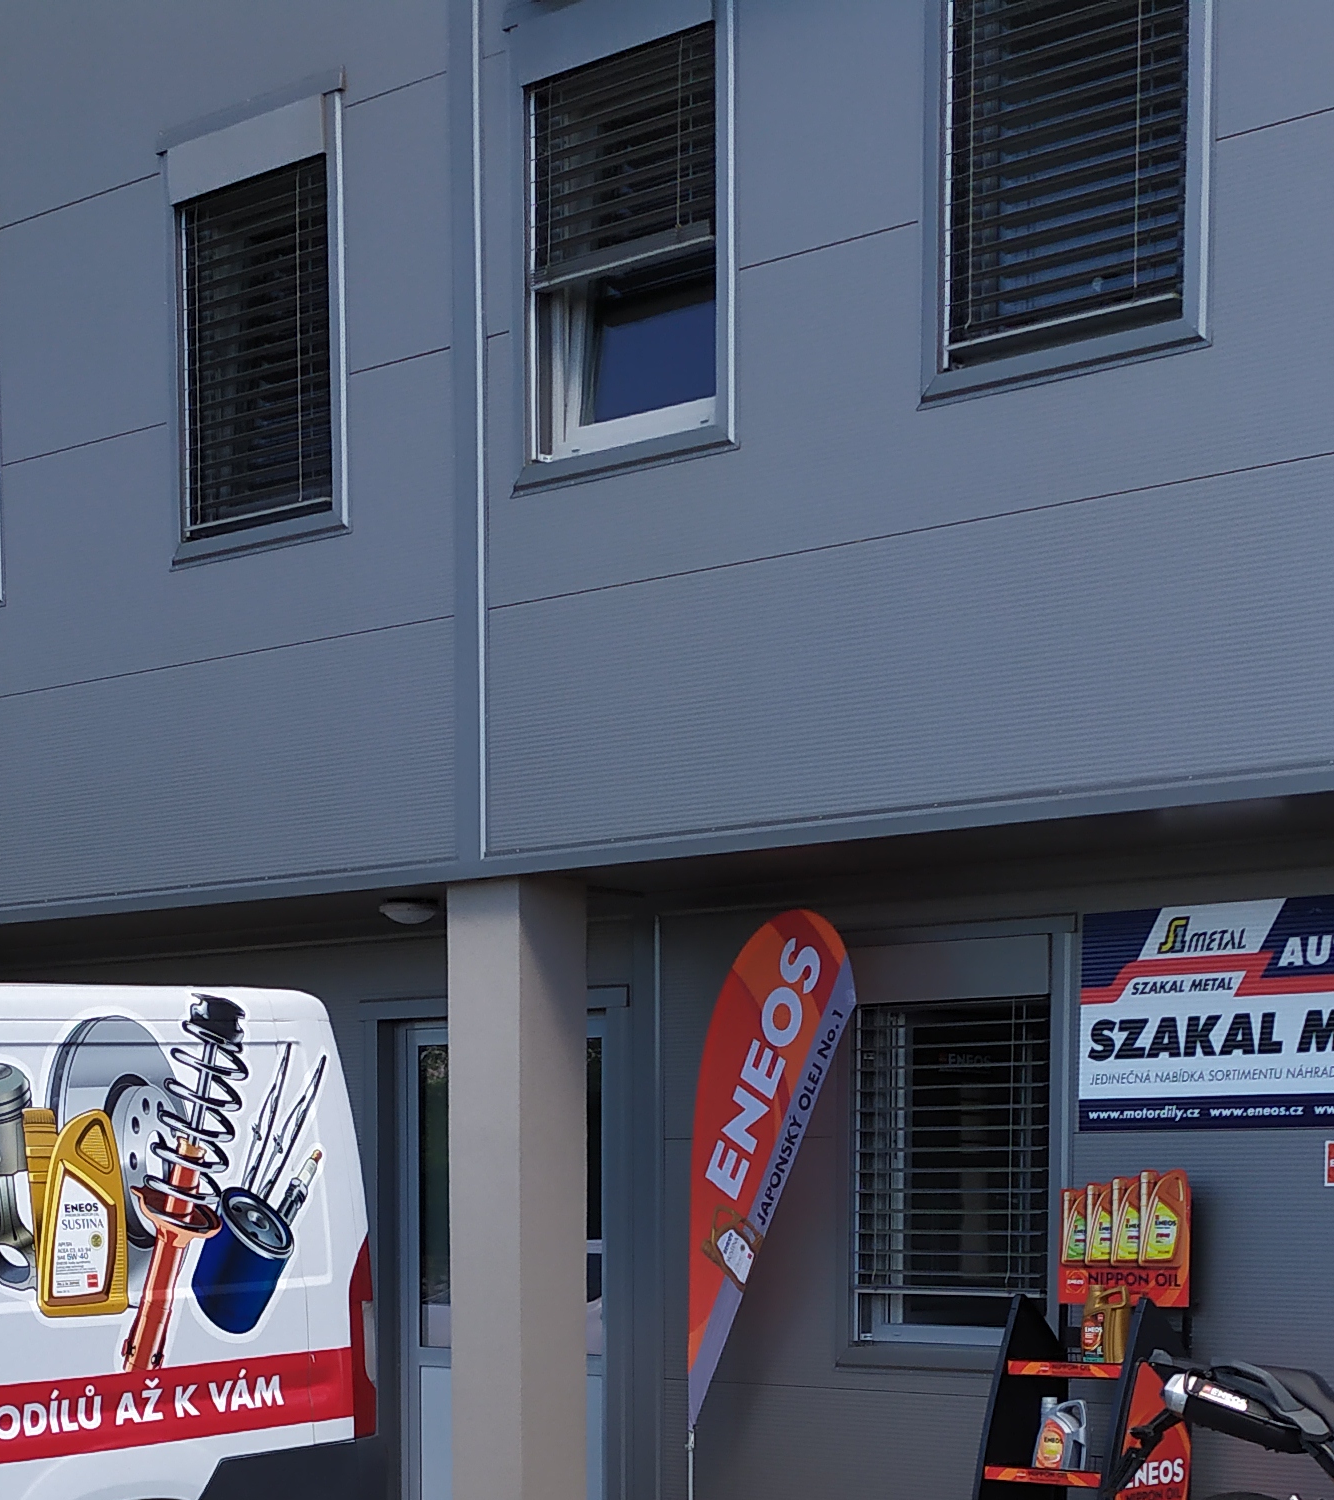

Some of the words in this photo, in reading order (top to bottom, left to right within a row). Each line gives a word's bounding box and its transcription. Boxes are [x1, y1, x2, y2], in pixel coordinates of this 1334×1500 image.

[1187, 928, 1246, 952] METAL
[1131, 979, 1184, 995] SZAKAL
[1188, 977, 1233, 992] METAL
[1088, 1011, 1283, 1061] SZAKAL
[705, 938, 821, 1200] ENEOS
[1090, 1070, 1151, 1086] JEDINEČNÁ
[1154, 1068, 1205, 1083] NABÍDKA
[1208, 1067, 1283, 1082] SORTIMENTU
[1210, 1104, 1304, 1118] www.eneos.cz
[756, 1114, 803, 1226] JAPONSKÝ
[798, 1062, 823, 1112] OLEJ
[817, 1024, 840, 1060] No.
[64, 1202, 99, 1213] ENEOS
[62, 1219, 104, 1230] SUSTINA
[1088, 1272, 1149, 1286] NIPPON
[1155, 1272, 1181, 1287] OIL
[115, 1377, 163, 1425] AŽ
[174, 1384, 200, 1418] K
[208, 1368, 284, 1413] VÁM
